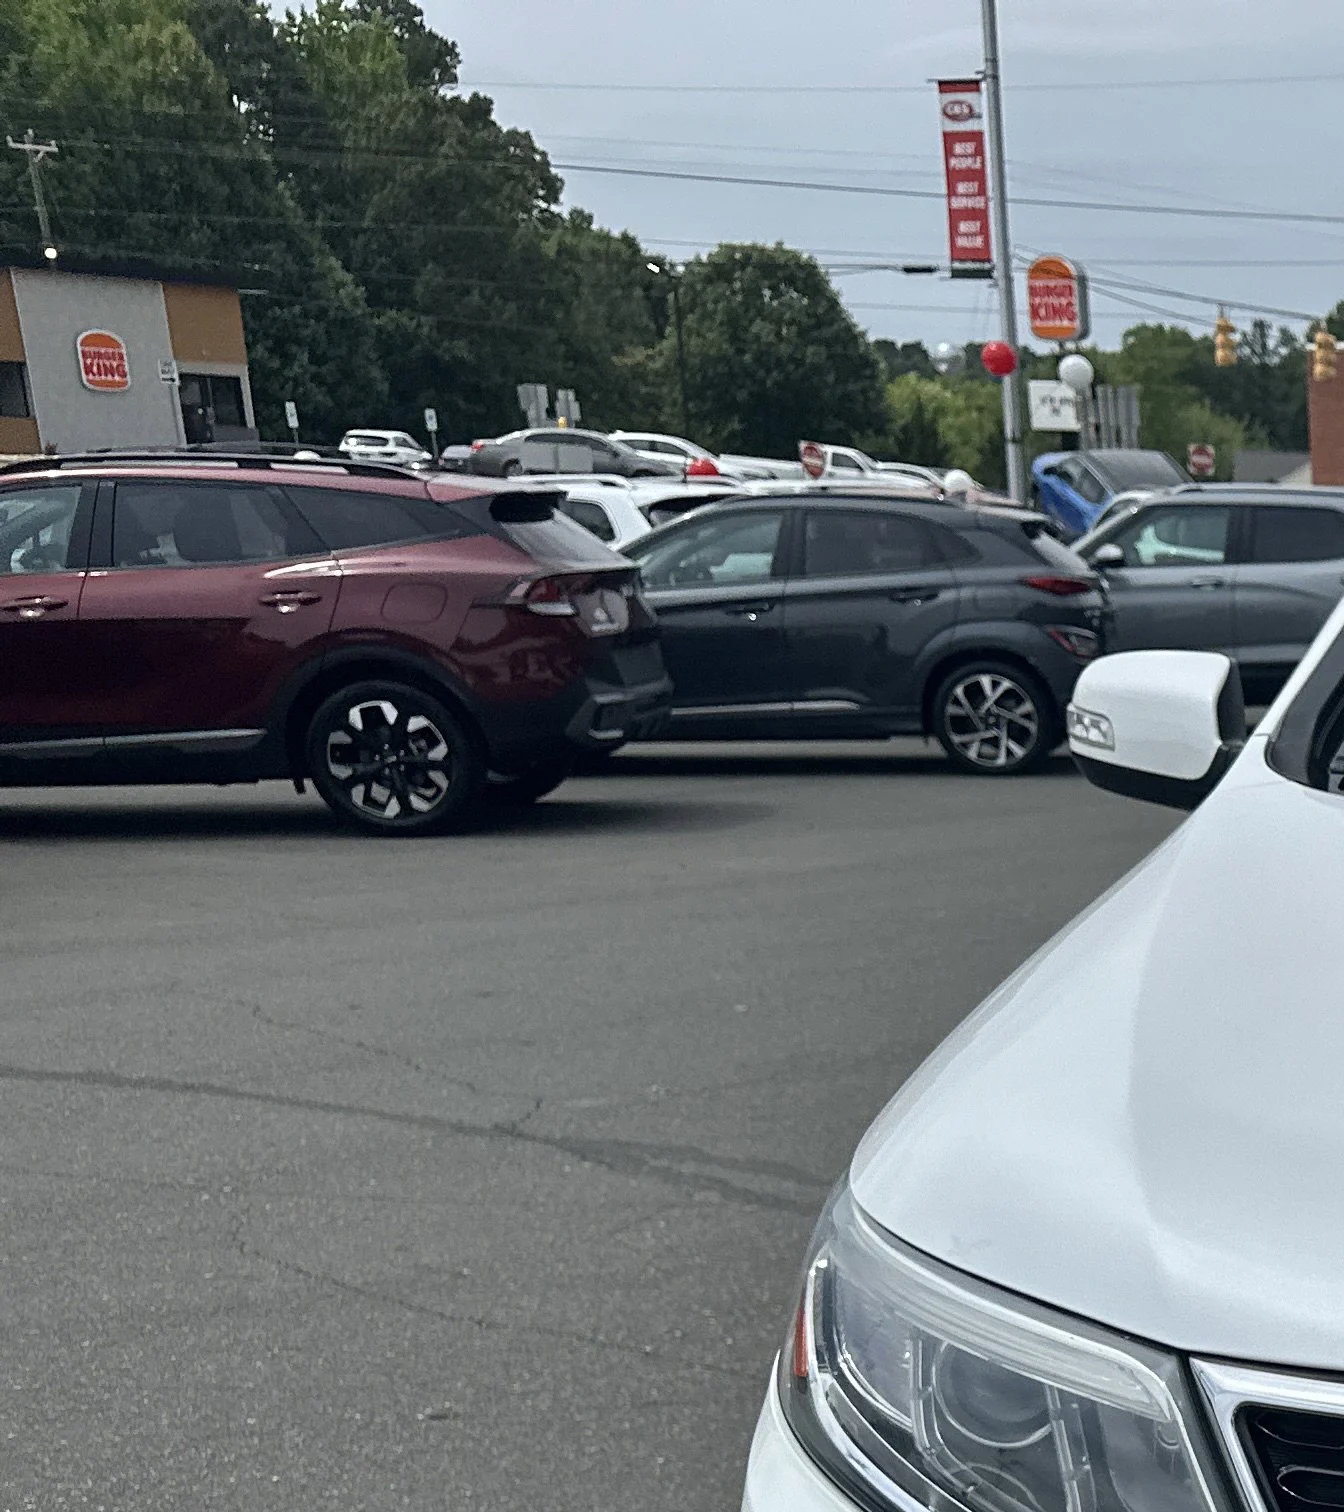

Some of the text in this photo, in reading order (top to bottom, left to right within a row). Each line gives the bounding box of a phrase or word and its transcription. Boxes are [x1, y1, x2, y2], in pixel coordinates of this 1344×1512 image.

[1029, 284, 1073, 299] BURGER
[1029, 302, 1077, 322] KING
[81, 349, 125, 362] BURGER
[83, 359, 128, 379] KING
